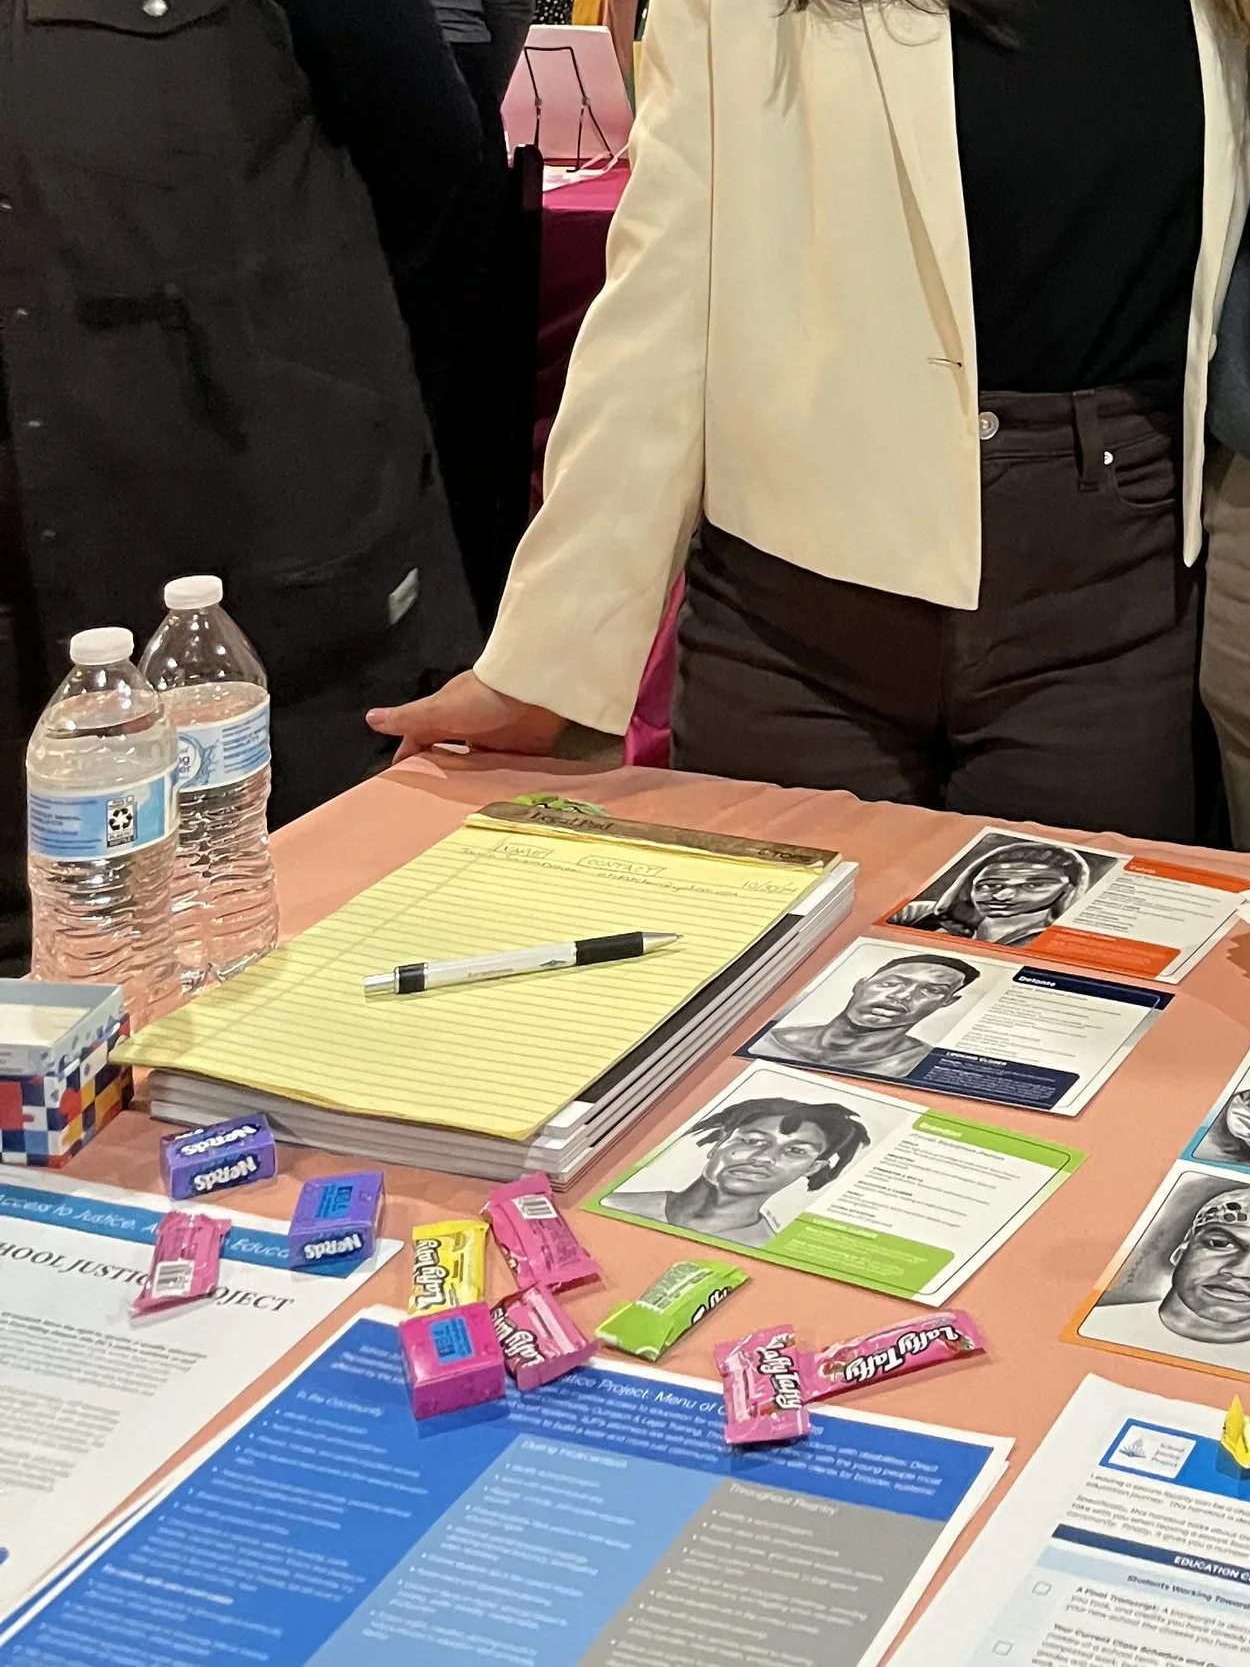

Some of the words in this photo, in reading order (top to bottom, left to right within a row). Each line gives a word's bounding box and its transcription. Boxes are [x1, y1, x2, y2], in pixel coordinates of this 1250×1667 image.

[64, 1255, 151, 1291] JUSTIC
[896, 1325, 960, 1355] Laffy
[844, 1352, 904, 1383] Taffy
[654, 1391, 696, 1408] Menu
[698, 1402, 717, 1412] of
[729, 1483, 792, 1504] Throughout
[1174, 1555, 1239, 1577] EDUCATION
[1127, 1574, 1169, 1590] Students
[1171, 1585, 1212, 1601] Working
